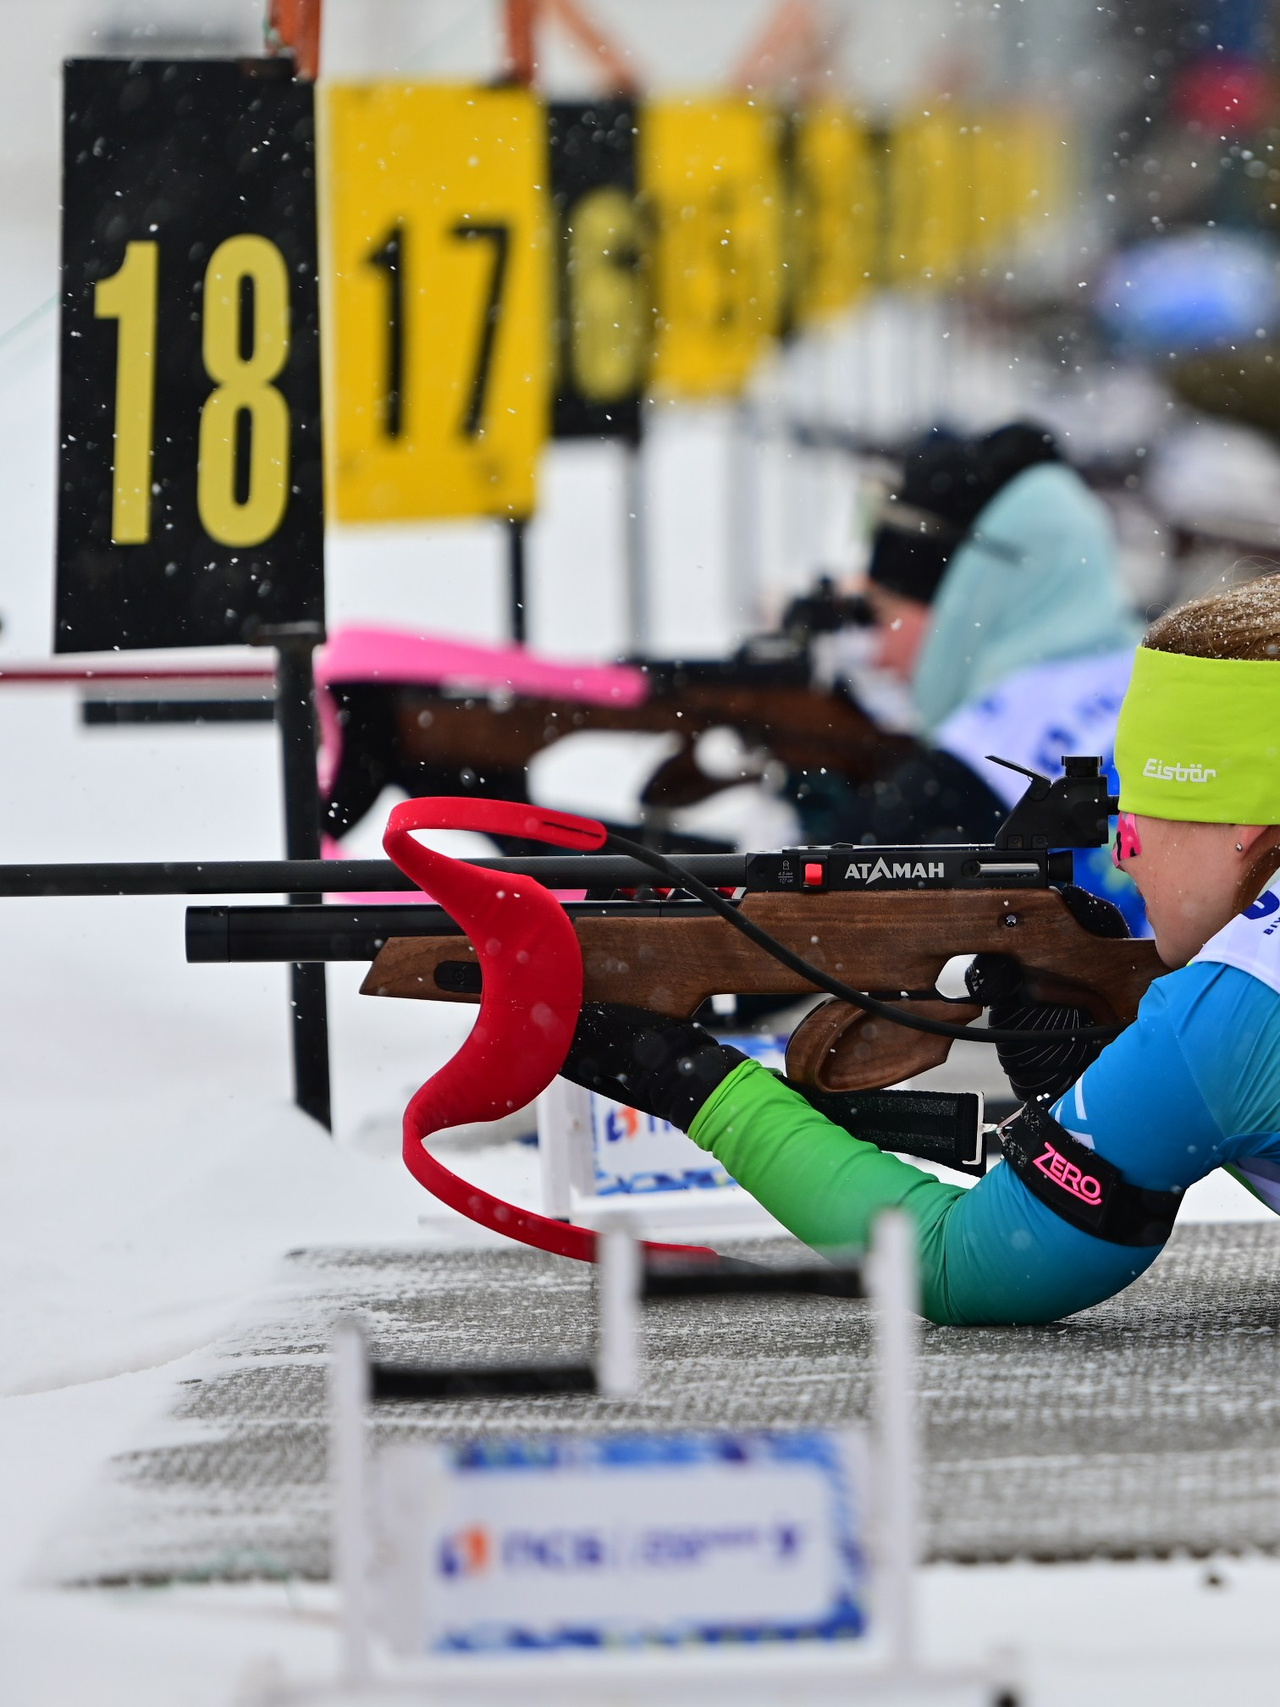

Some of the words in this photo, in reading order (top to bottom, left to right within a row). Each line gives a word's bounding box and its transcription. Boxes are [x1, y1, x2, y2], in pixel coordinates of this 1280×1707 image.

[94, 233, 291, 548] 18
[367, 218, 513, 444] 17
[569, 188, 641, 398] 6
[1142, 758, 1217, 783] Eisbär
[1033, 1142, 1102, 1205] ZERO
